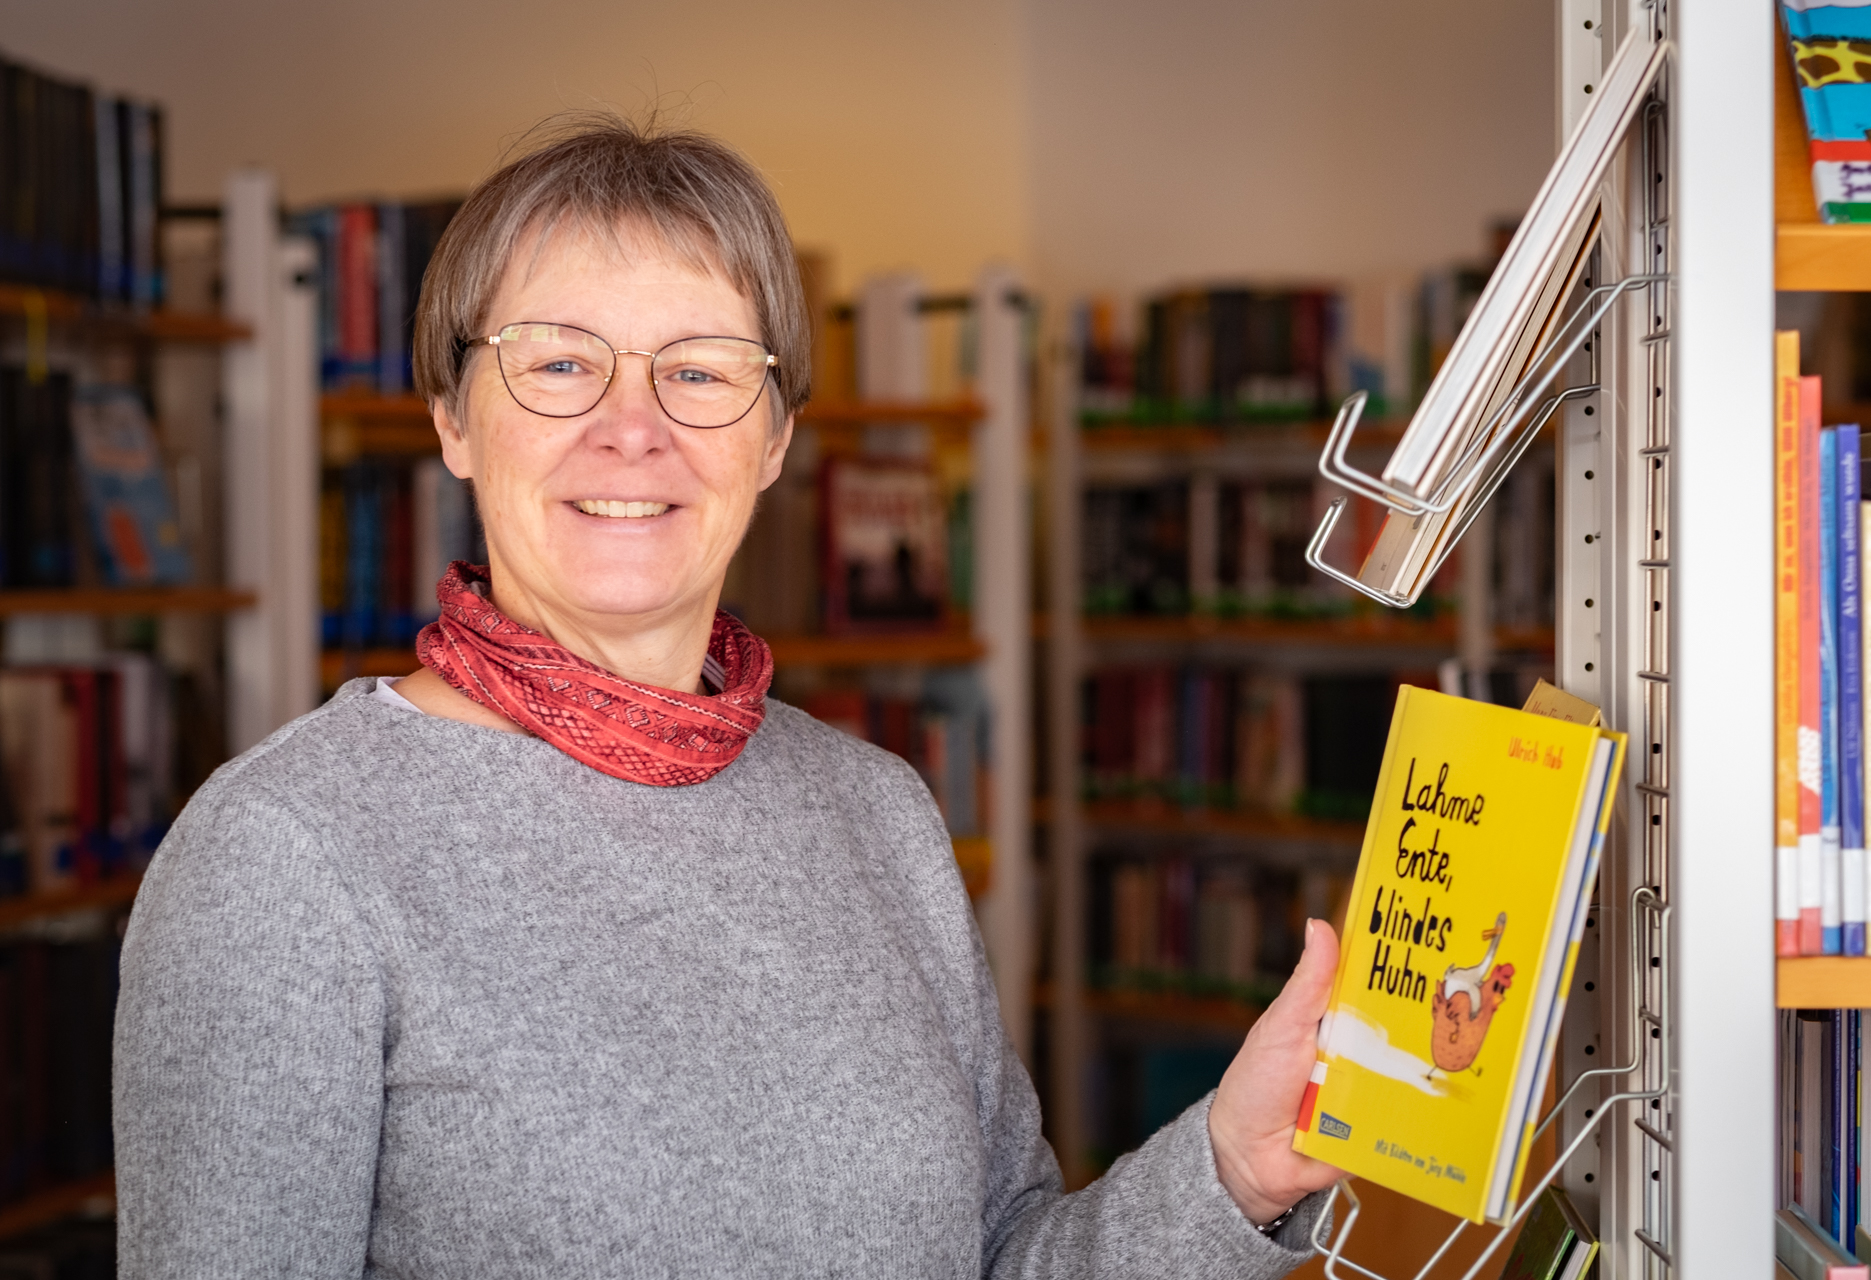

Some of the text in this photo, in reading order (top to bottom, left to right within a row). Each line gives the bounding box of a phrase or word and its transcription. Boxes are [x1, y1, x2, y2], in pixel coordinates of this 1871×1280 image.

[1840, 452, 1856, 495] wurde
[1508, 736, 1539, 764] Ulrich
[1402, 757, 1485, 826] Lahme
[1396, 816, 1453, 893] Ente,
[1369, 885, 1453, 953] blindes
[1367, 938, 1427, 1003] Huhn
[1321, 1116, 1351, 1137] CARLSEN
